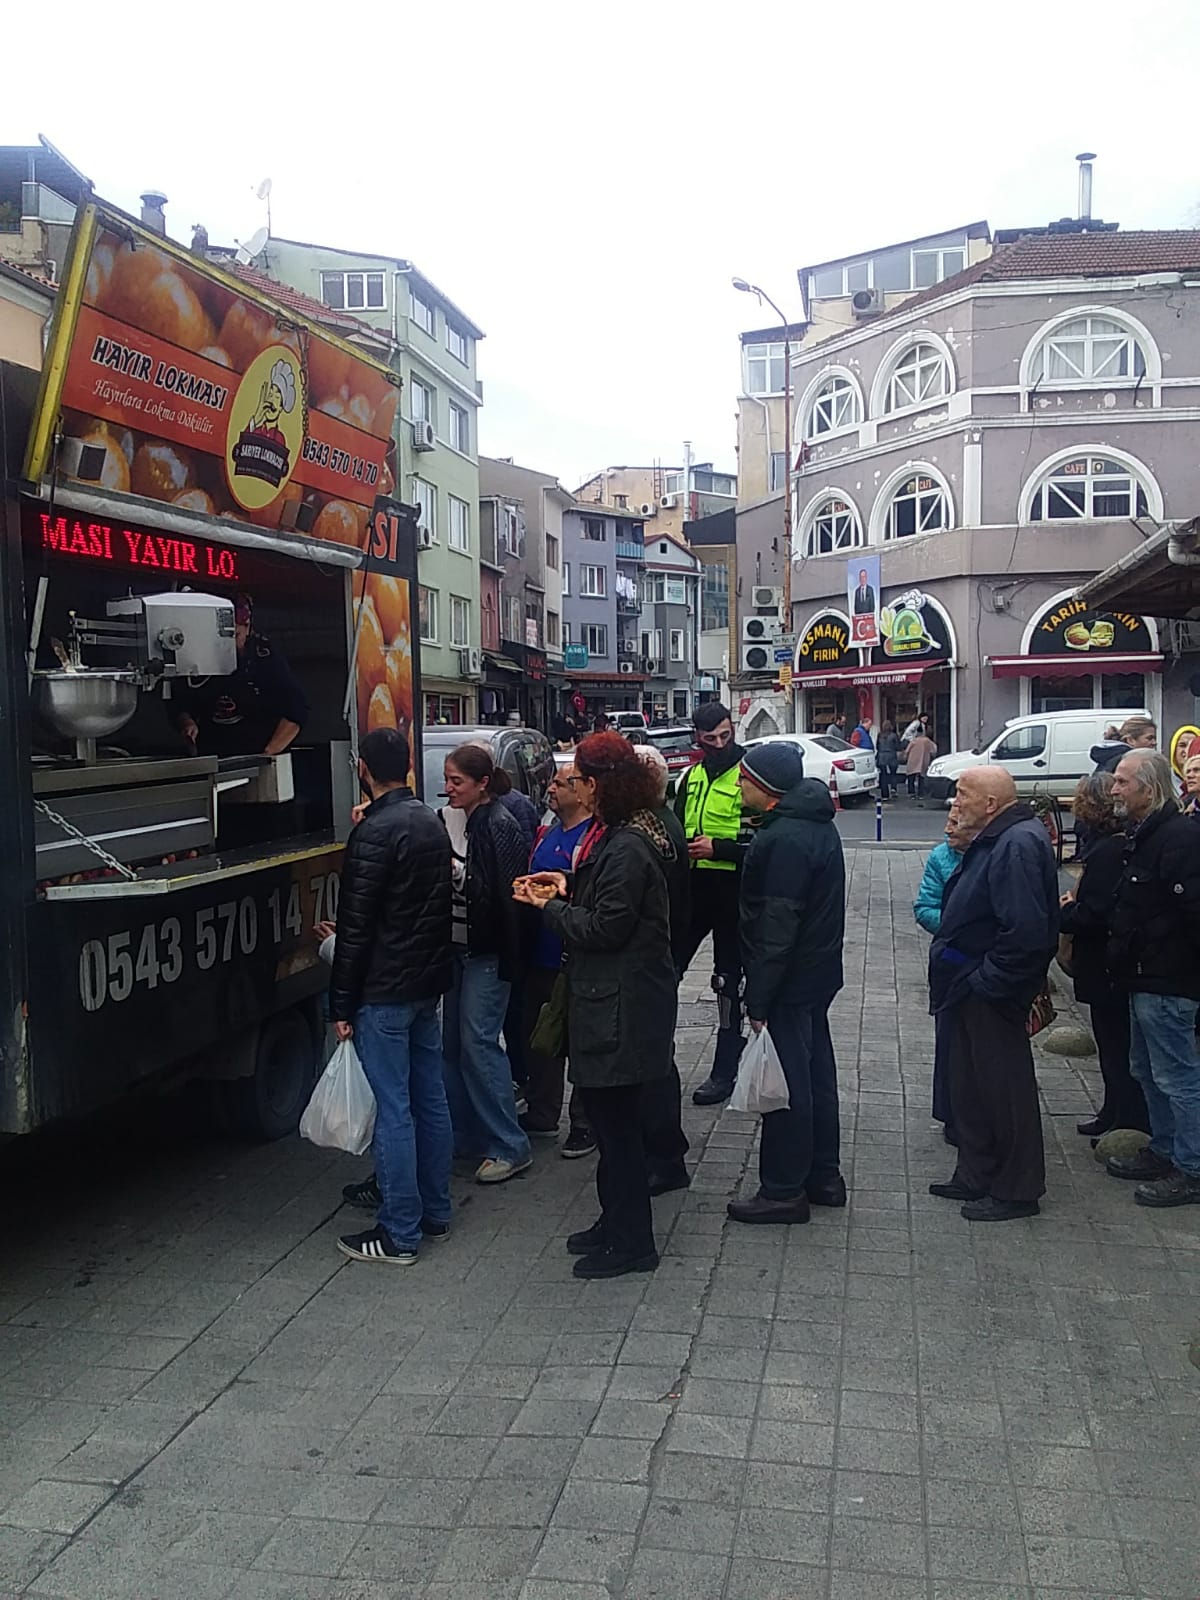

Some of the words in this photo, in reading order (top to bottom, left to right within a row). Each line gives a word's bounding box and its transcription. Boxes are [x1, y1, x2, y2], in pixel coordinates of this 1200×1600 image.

[90, 336, 153, 383] HAYIR
[153, 361, 229, 411] LOKMASI
[92, 379, 143, 409] Hayırlara
[144, 398, 176, 422] Lokma
[302, 436, 331, 468] 0543
[330, 448, 352, 476] 570
[351, 456, 365, 481] 14
[363, 461, 379, 486] 70
[1064, 463, 1086, 474] CAFE
[567, 647, 586, 655] A101
[813, 647, 839, 662] FIRIN
[79, 916, 183, 1012] 0543
[196, 895, 258, 970] 570
[268, 882, 302, 943] 14
[310, 872, 341, 926] 70
